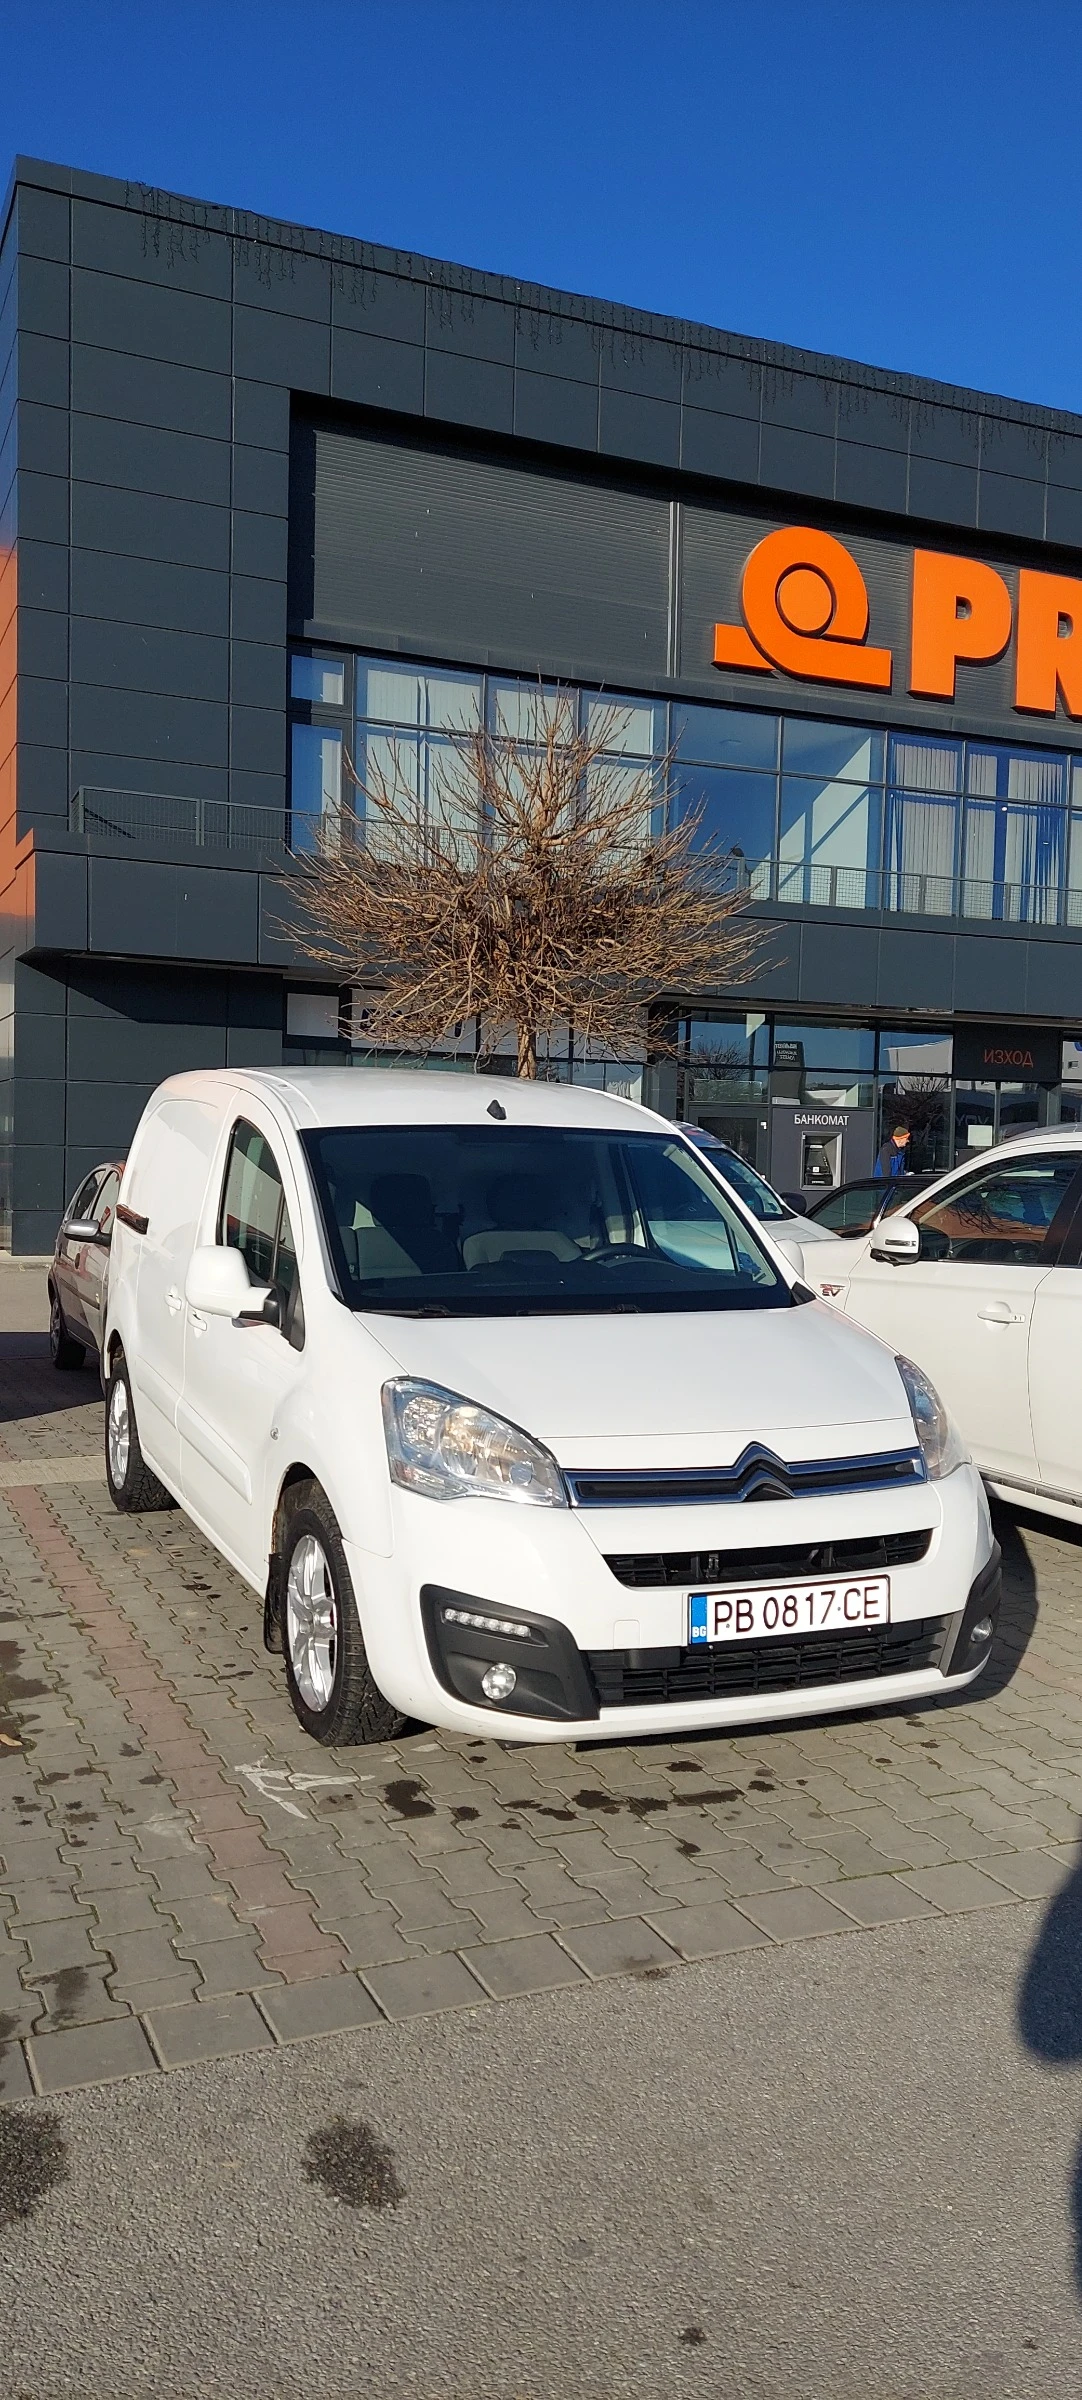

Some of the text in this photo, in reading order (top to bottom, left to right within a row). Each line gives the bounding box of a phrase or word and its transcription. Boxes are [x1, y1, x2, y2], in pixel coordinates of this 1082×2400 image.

[983, 1048, 1034, 1069] ИЗХОД
[794, 1113, 850, 1126] БАНКОМАТ
[714, 1585, 880, 1636] PB 0817 CE
[691, 1625, 707, 1638] BG
